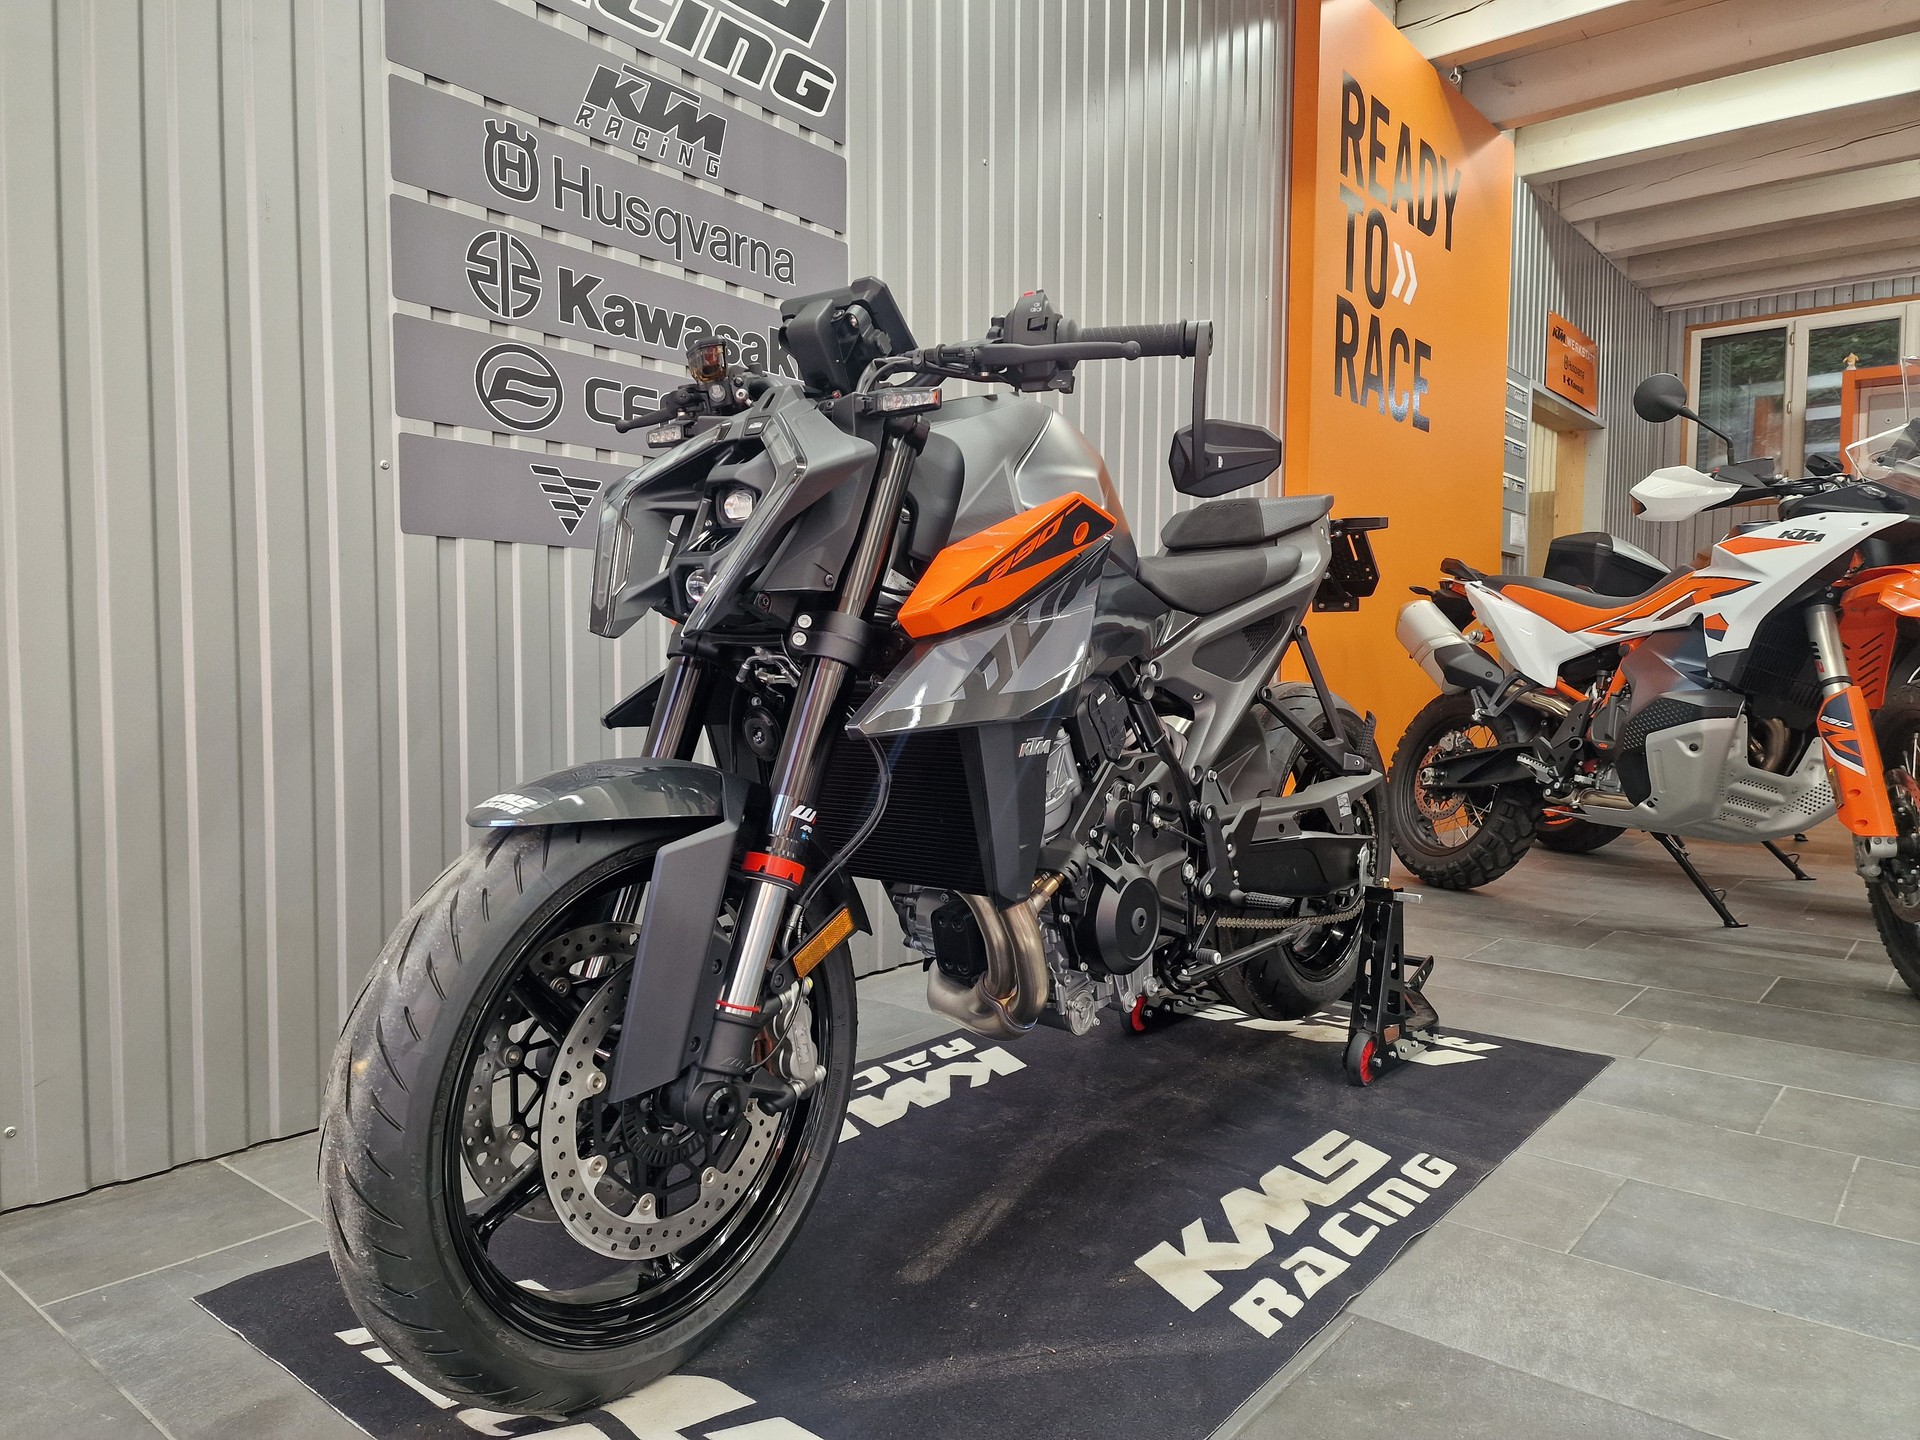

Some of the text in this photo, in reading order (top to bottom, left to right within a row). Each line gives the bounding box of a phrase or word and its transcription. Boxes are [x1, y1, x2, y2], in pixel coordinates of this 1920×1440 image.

[583, 64, 727, 157] KTM
[1340, 69, 1462, 252] READY
[552, 154, 796, 286] Husqvarna
[1339, 183, 1390, 309] TO
[558, 266, 806, 382] Kawasak
[1334, 294, 1433, 433] RACE
[986, 512, 1065, 582] 990
[1777, 528, 1826, 542] KTM
[1018, 736, 1052, 758] KTM
[838, 1046, 1028, 1144] KM
[852, 1037, 977, 1092] RAC
[1134, 1129, 1392, 1312] KMS
